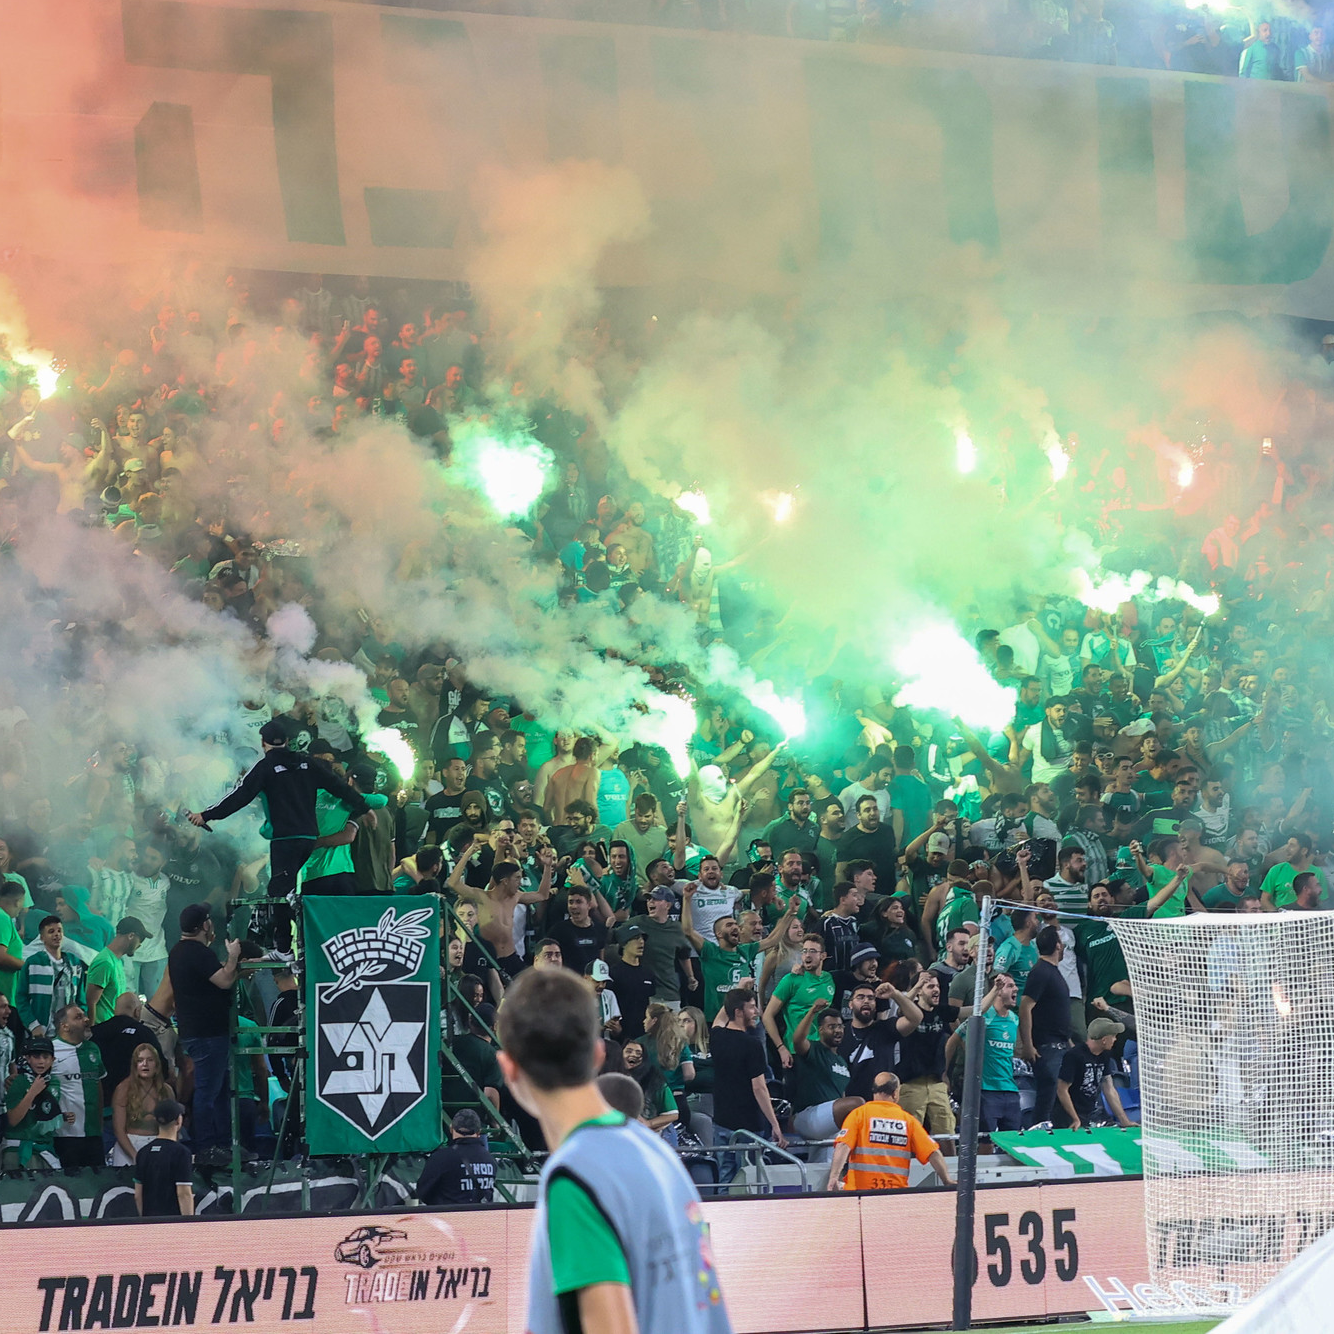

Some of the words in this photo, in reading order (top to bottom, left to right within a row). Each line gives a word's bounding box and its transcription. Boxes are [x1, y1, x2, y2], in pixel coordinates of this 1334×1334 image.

[952, 1209, 1078, 1287] 535
[37, 1271, 204, 1332] TRADEIN
[211, 1265, 319, 1324] בריאל
[344, 1269, 430, 1304] TRADEIN
[434, 1265, 491, 1300] בריאל
